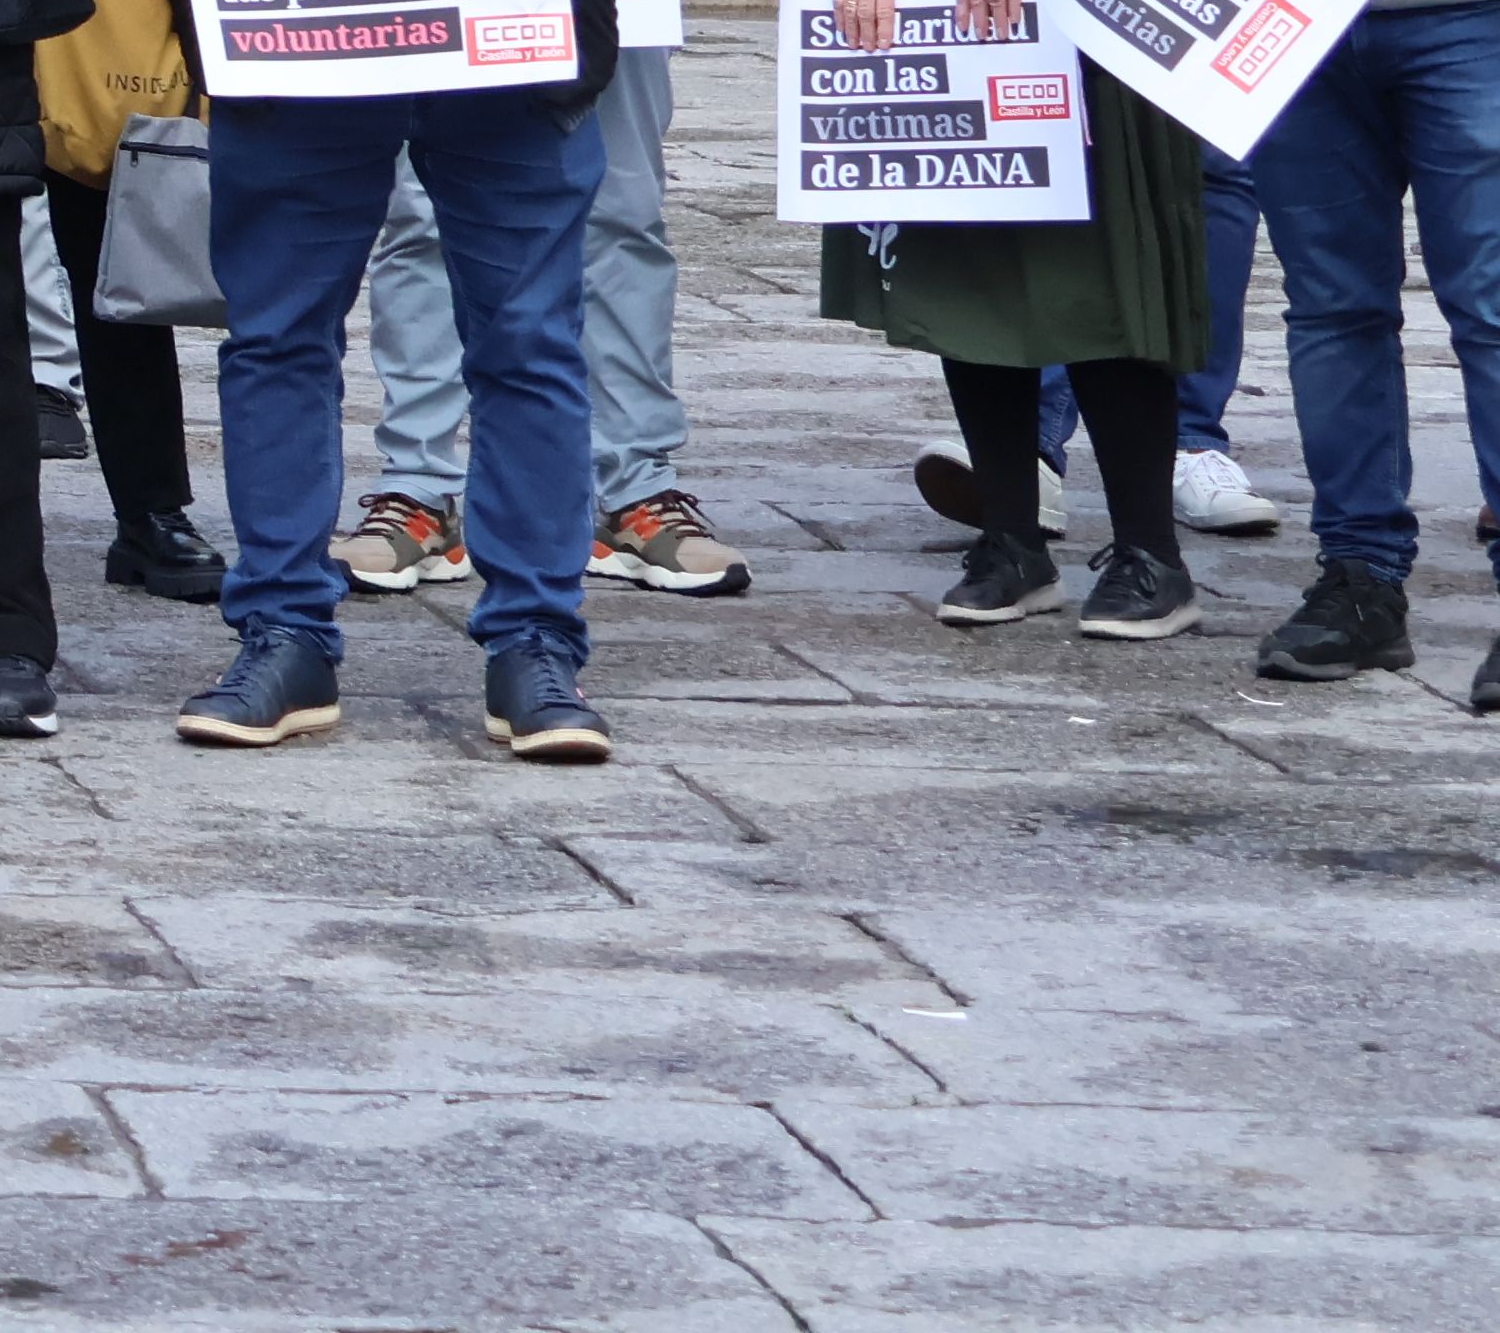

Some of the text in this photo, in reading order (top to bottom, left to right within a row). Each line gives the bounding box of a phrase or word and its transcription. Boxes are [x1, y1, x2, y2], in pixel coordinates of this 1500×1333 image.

[230, 17, 450, 54] voluntarias
[483, 24, 555, 42] CCOO
[477, 48, 565, 61] Castilla y León
[811, 59, 938, 94] con las
[1003, 84, 1058, 99] CCOO
[810, 107, 974, 141] víctimas
[998, 105, 1065, 117] Castilla y León
[811, 153, 1034, 188] de la DANA
